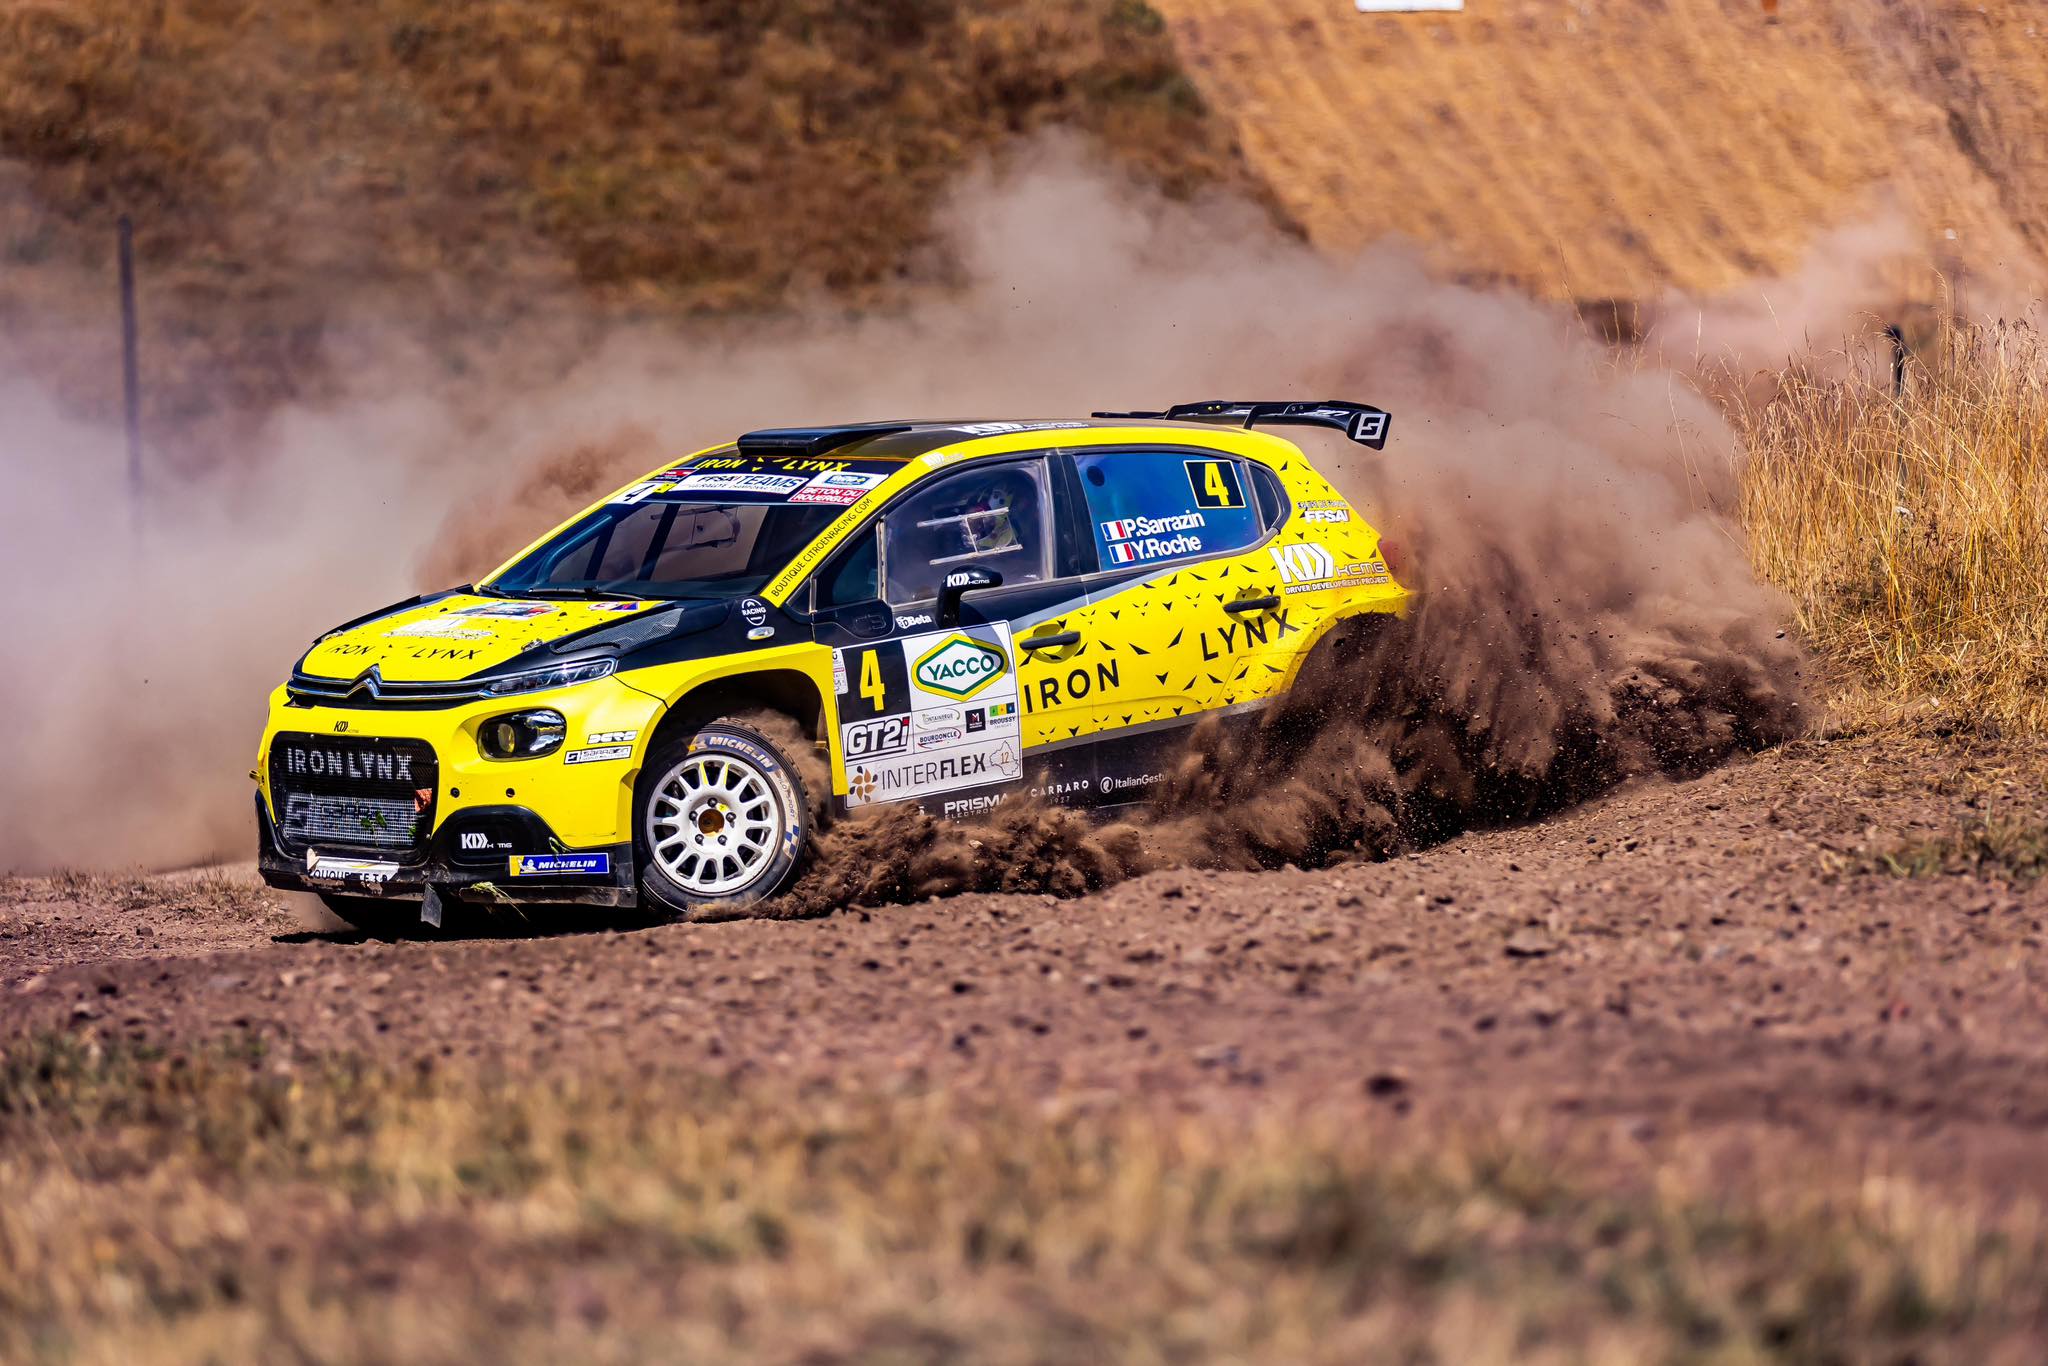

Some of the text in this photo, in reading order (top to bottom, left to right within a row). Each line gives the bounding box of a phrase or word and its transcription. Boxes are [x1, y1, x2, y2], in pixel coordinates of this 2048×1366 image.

[694, 459, 852, 472] IRON LYNX
[736, 475, 804, 488] TEAMS
[1203, 462, 1230, 506] 4
[1124, 510, 1205, 539] P.Sarrazin
[1131, 534, 1202, 560] Y.Roche
[1285, 576, 1389, 595] DRIVER DEVELOPMENT PROJECT
[324, 643, 484, 660] IRON LYNX
[1024, 608, 1301, 714] IRON LYNX
[927, 654, 995, 681] YACCO
[860, 649, 886, 712] 4
[919, 731, 958, 743] BOURDONCLE
[709, 736, 775, 769] MICHELIN
[1000, 751, 1010, 765] 12
[288, 748, 413, 781] IRON LYNX
[1030, 780, 1089, 798] CARRARO
[944, 793, 1008, 814] PRISMA
[538, 860, 597, 869] MICHELIN
